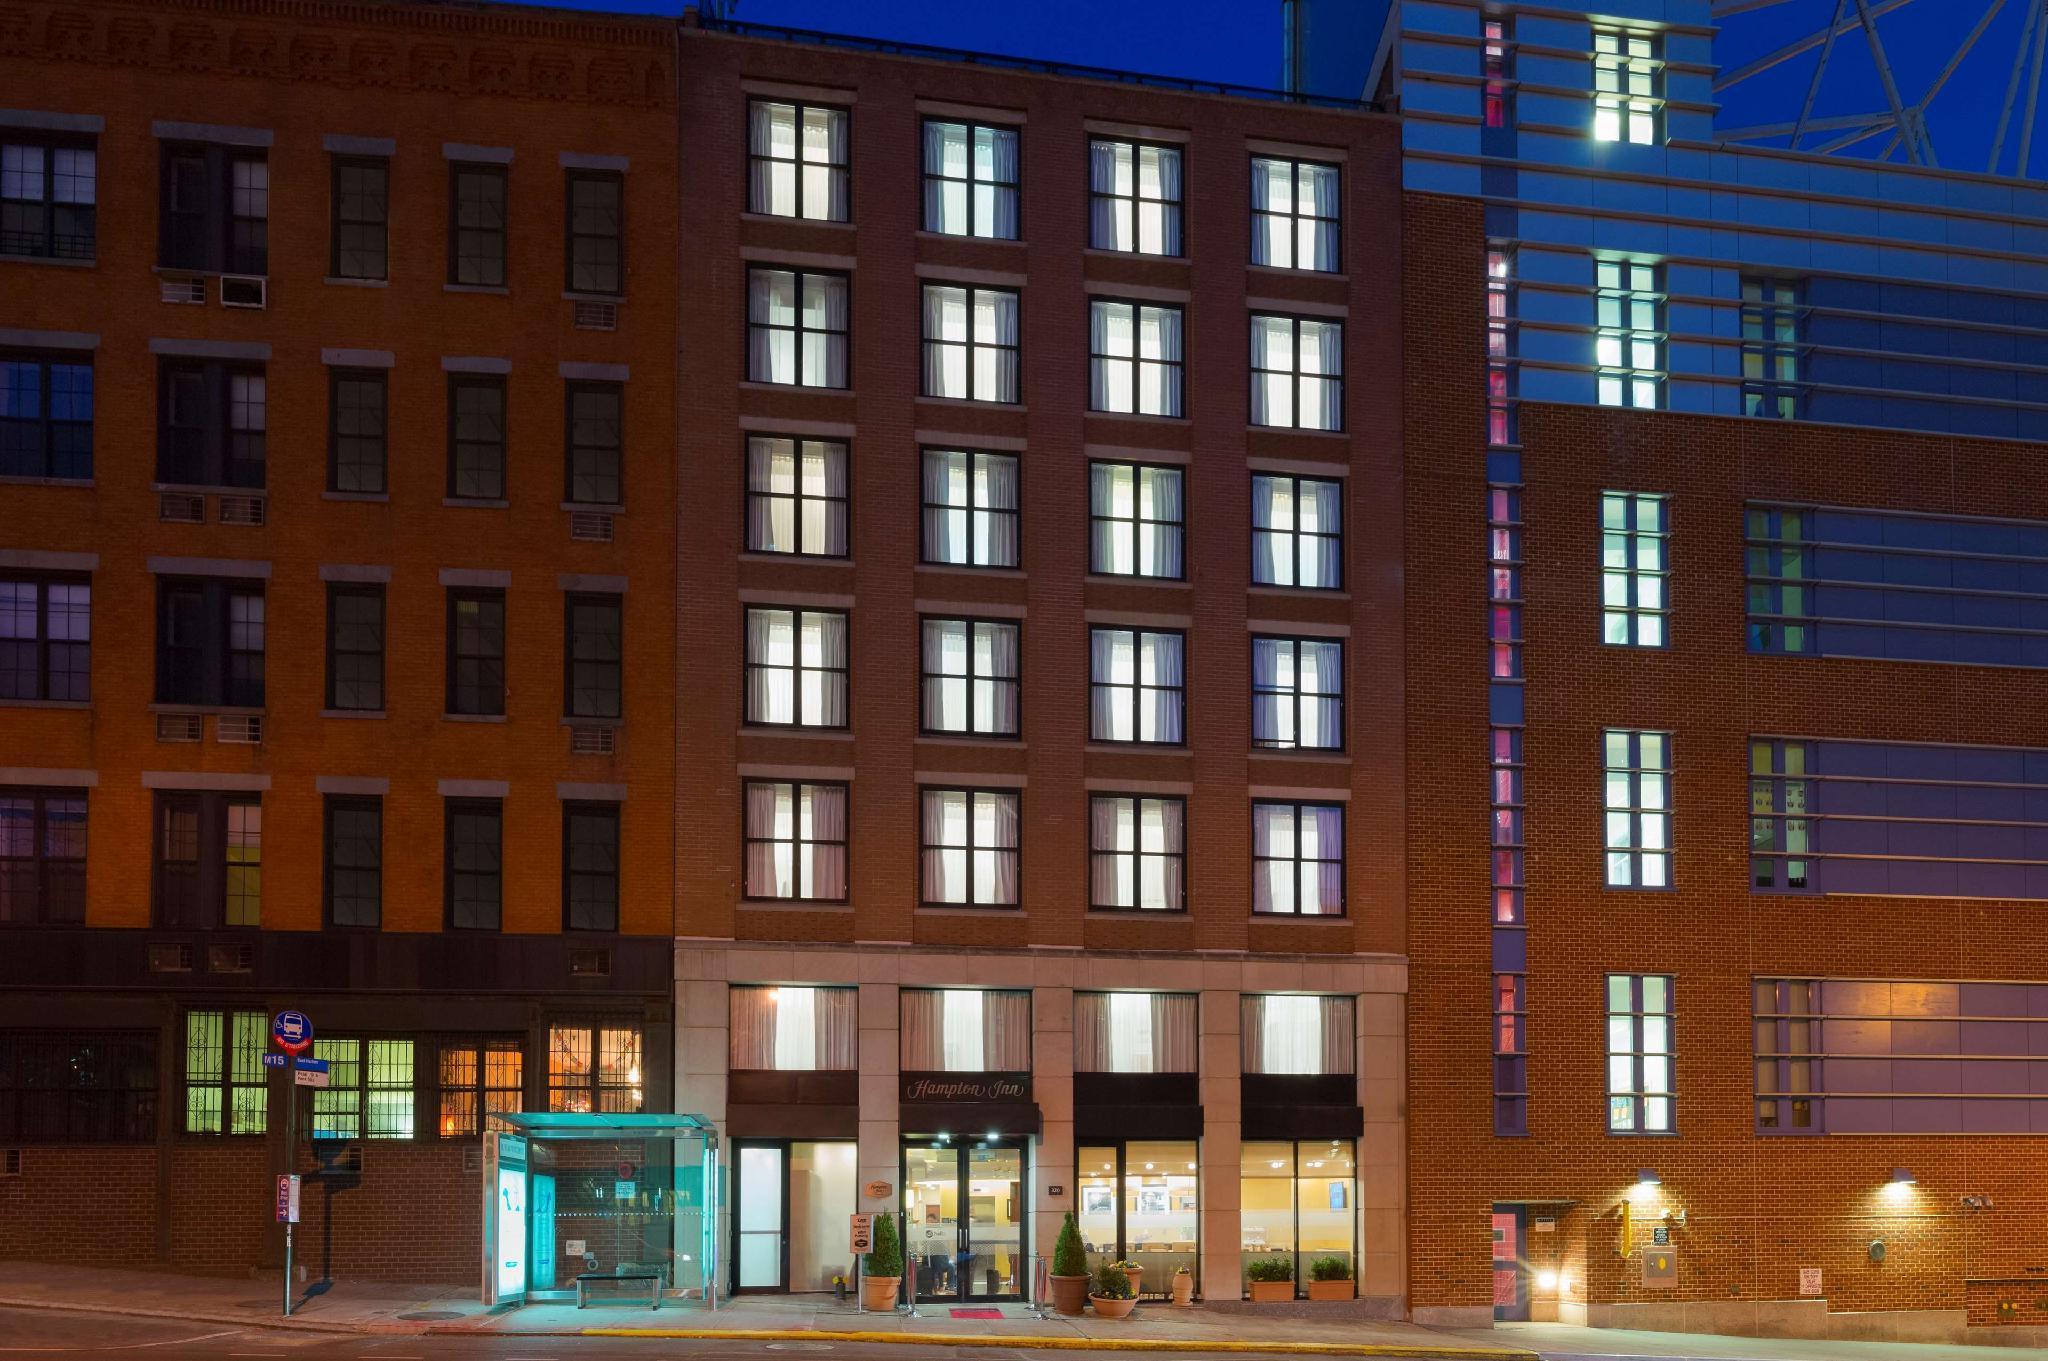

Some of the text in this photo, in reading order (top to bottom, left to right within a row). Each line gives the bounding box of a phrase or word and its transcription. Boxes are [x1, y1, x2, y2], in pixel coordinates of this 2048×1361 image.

[264, 1055, 284, 1065] M15
[907, 1079, 1024, 1100] Hampton Inn
